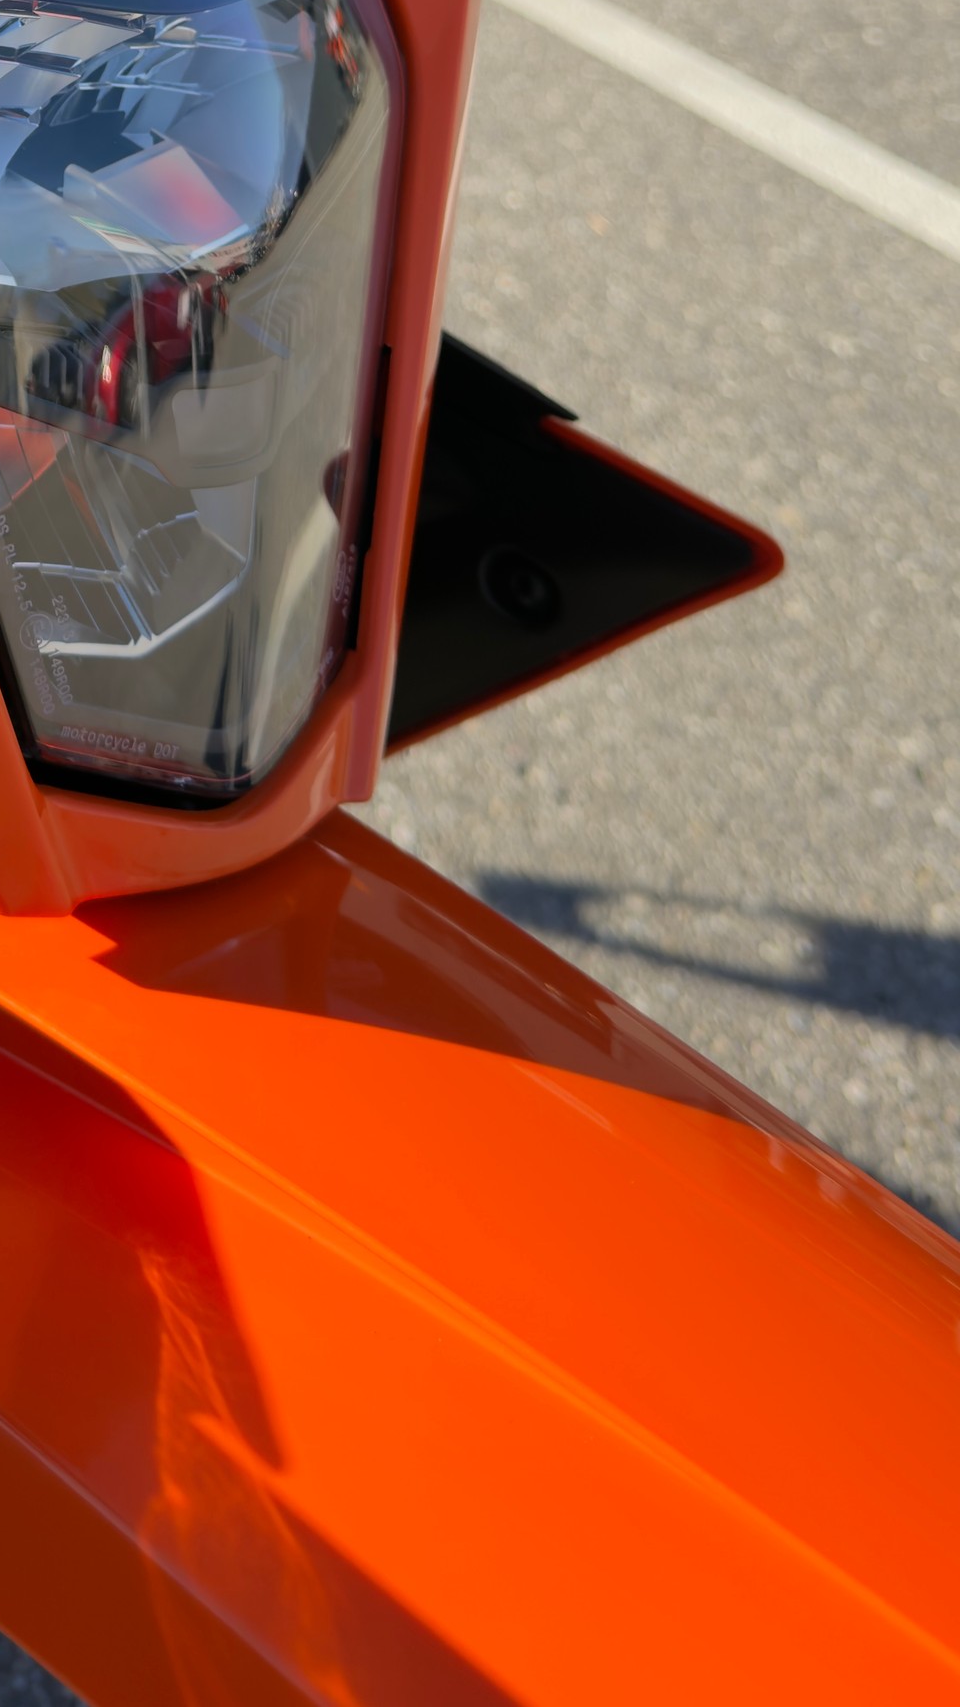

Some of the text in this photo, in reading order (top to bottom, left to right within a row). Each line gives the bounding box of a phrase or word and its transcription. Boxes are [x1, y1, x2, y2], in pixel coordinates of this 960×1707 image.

[48, 649, 74, 706] 149R00
[60, 724, 180, 759] motorcycle DOT
